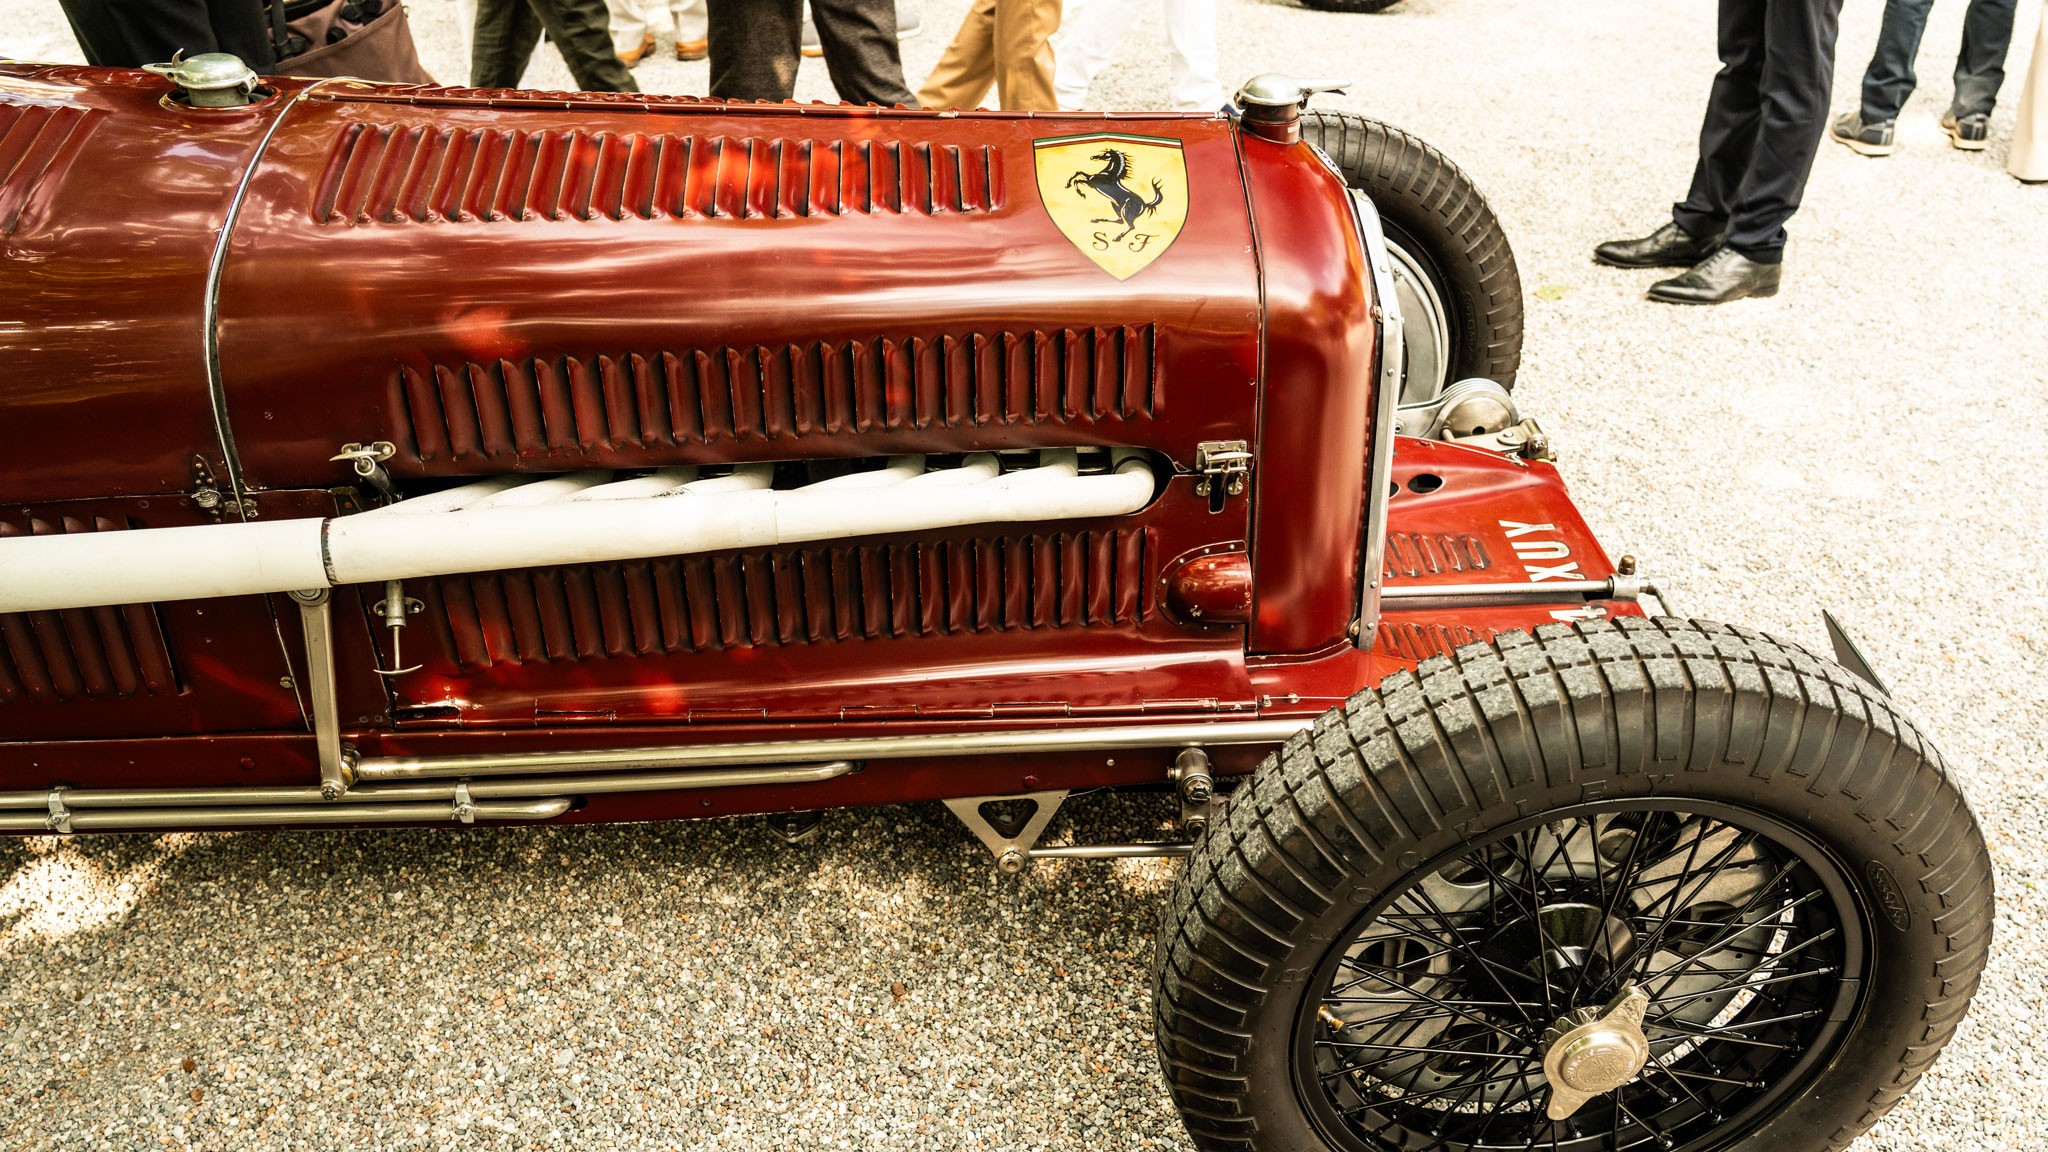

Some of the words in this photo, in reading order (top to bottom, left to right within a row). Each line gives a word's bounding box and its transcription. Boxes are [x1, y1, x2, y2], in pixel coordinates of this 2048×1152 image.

[1092, 231, 1110, 251] S
[1128, 233, 1160, 253] F
[1498, 519, 1586, 583] XUY
